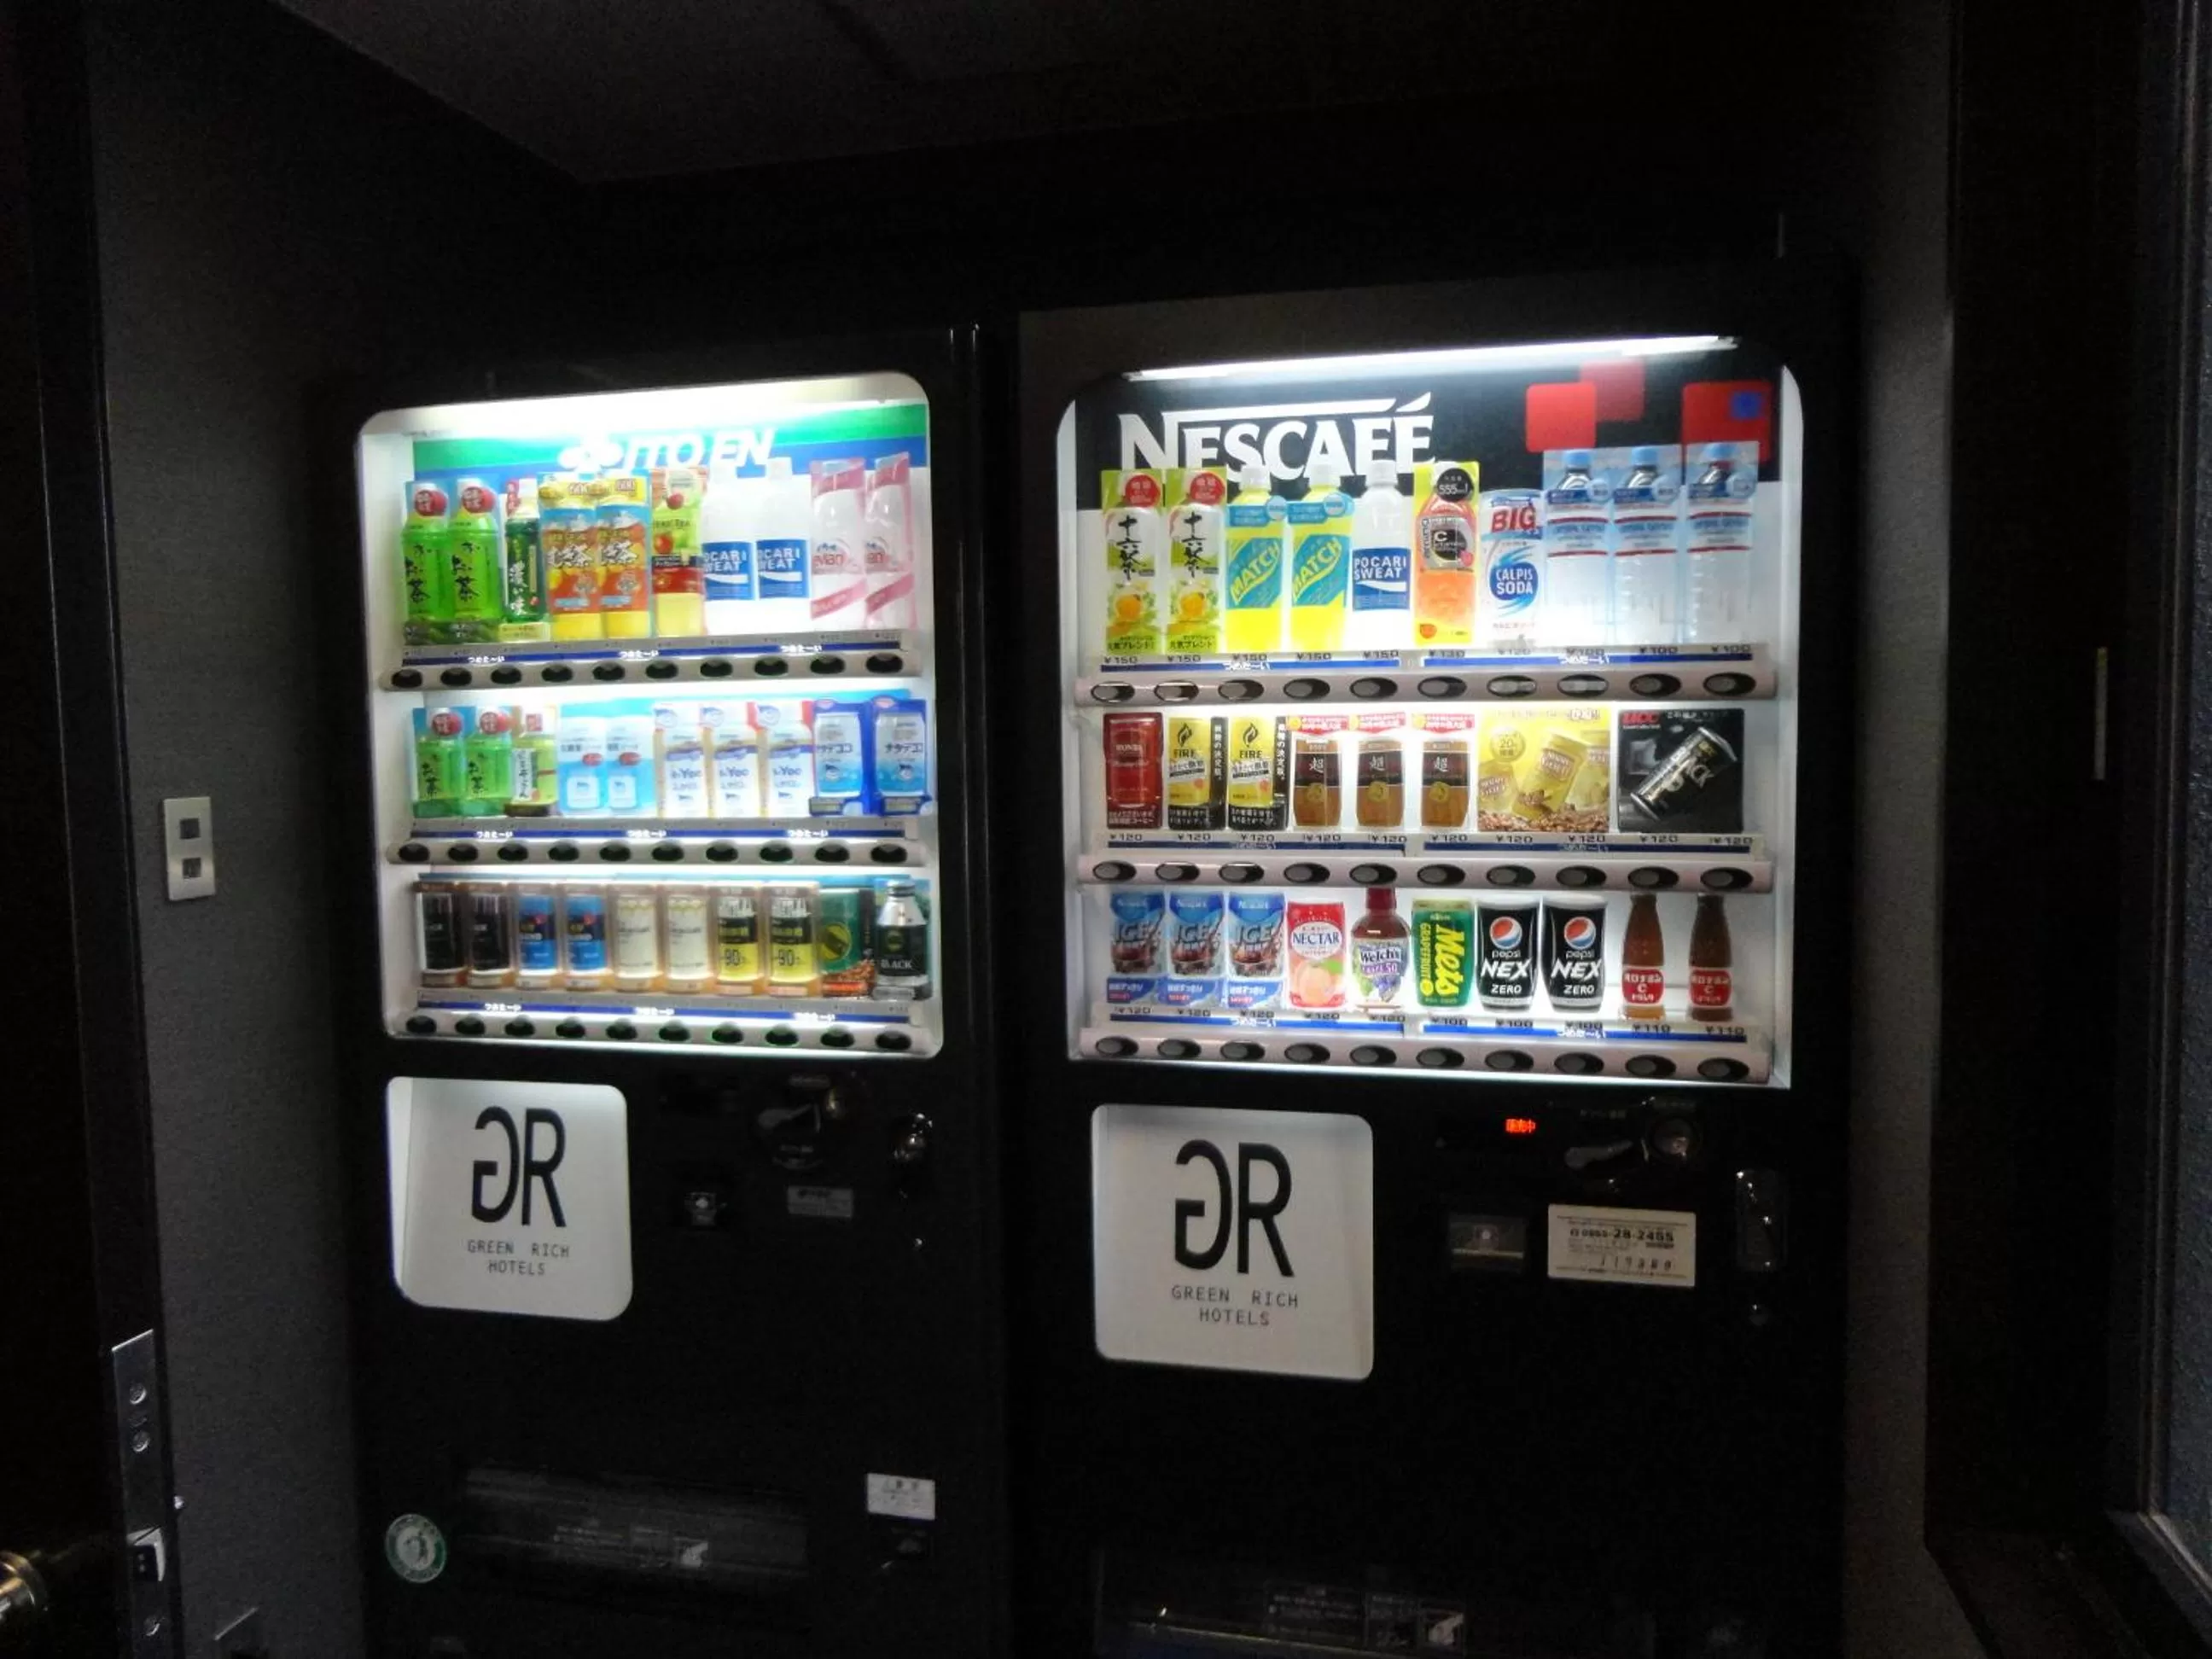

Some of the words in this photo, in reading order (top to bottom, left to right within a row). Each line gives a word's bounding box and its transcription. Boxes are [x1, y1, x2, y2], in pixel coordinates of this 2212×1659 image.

[624, 434, 704, 469] ITO
[709, 428, 775, 467] EN
[1491, 505, 1536, 533] BIG
[703, 549, 747, 562] OCARI
[757, 547, 800, 560] OCARI
[704, 560, 742, 572] WEAT
[757, 558, 795, 570] WEAT
[1353, 557, 1407, 569] POCARI
[1231, 539, 1280, 605] MATCH
[1353, 568, 1401, 580] SWEAT
[1496, 568, 1534, 582] CALPIS
[1496, 582, 1534, 596] SODA
[1239, 749, 1263, 759] FIRE
[1292, 933, 1340, 946] NECTAR
[1359, 948, 1400, 963] Welch's
[1435, 924, 1465, 996] Mets
[1492, 950, 1522, 960] pepsi
[1565, 950, 1595, 960] pepsi
[880, 958, 913, 969] BLACK
[1481, 958, 1533, 981] NEX
[1551, 958, 1602, 981] NEX
[1491, 983, 1522, 995] ZERO
[1563, 984, 1595, 995] ZERO
[467, 1238, 515, 1254] GREEN
[531, 1243, 570, 1258] RICH
[488, 1260, 546, 1276] HOTELS
[1171, 1284, 1230, 1303] GREEN
[1251, 1290, 1299, 1308] RICH
[1199, 1307, 1271, 1327] HOTELS
